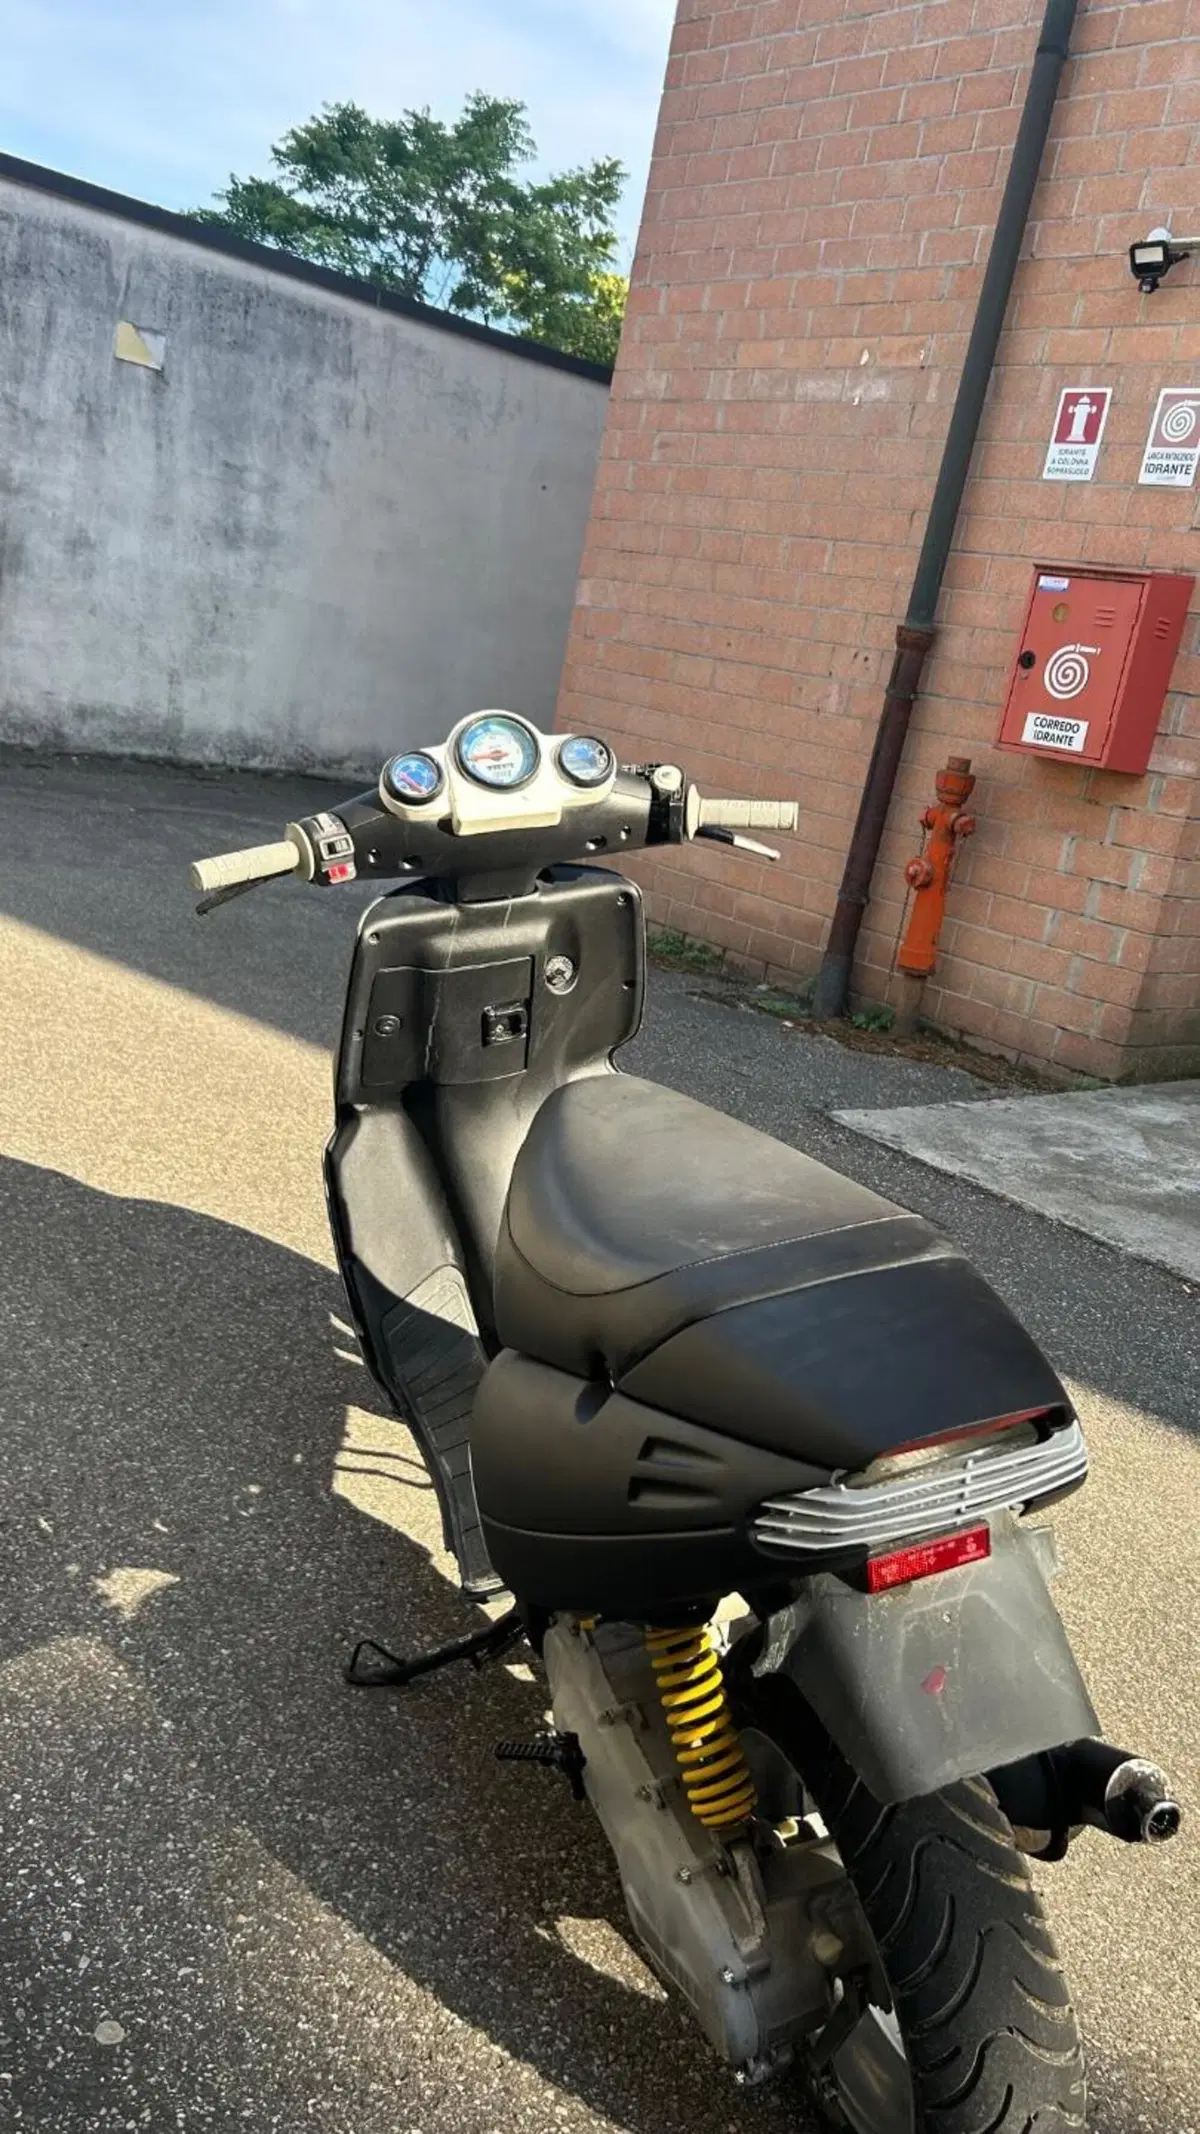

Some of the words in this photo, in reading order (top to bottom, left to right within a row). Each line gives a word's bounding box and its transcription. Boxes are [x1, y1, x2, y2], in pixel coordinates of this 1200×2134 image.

[1144, 463, 1193, 475] IDRANTE
[1033, 716, 1081, 734] CORREDO
[1033, 730, 1075, 747] IDRANTE
